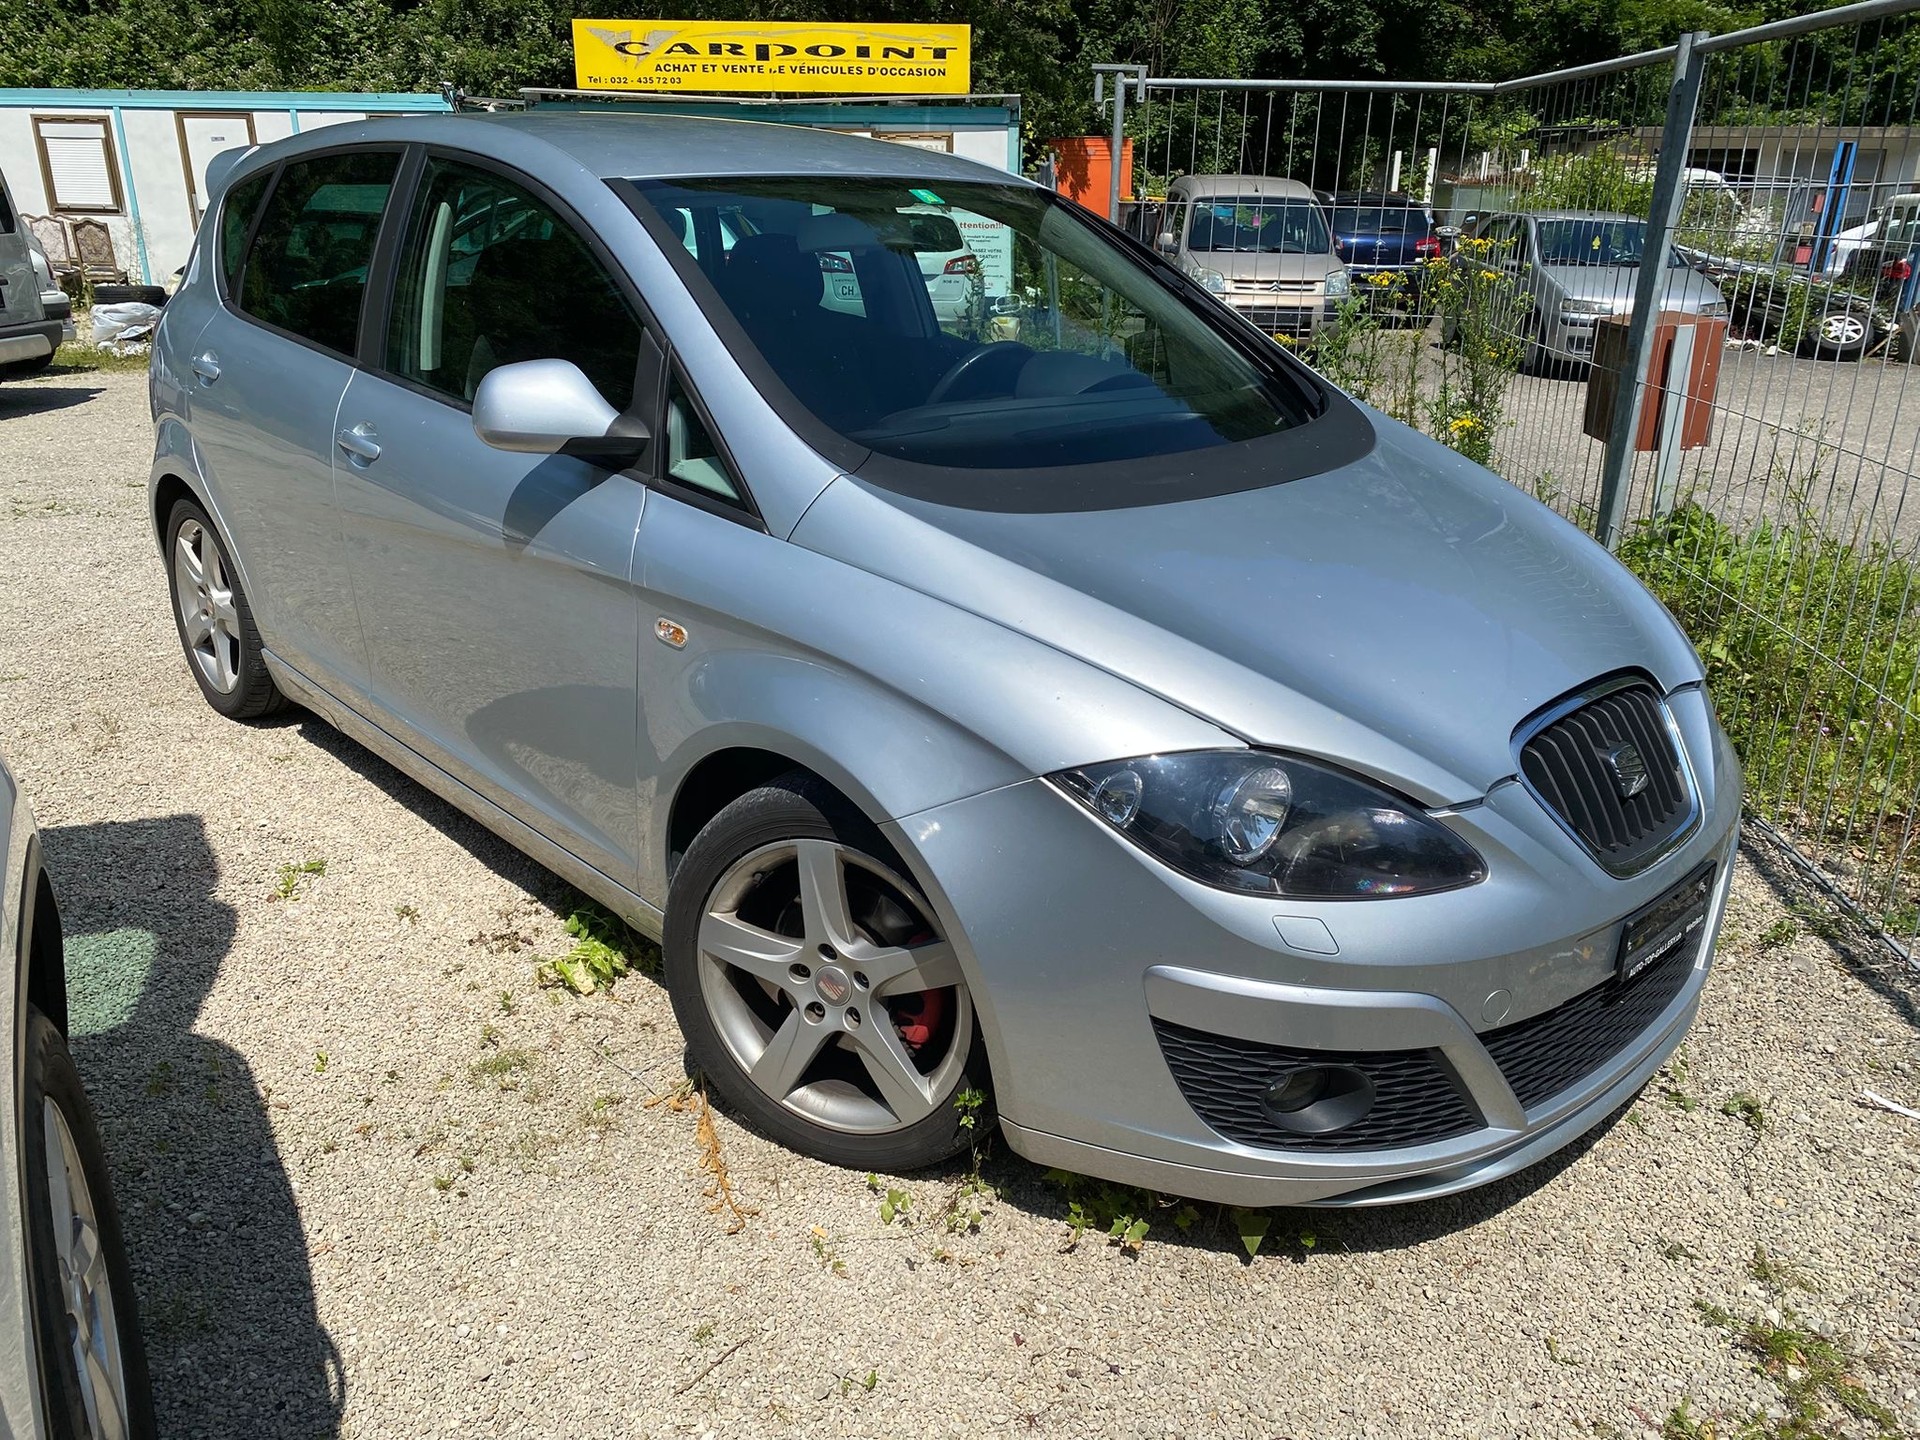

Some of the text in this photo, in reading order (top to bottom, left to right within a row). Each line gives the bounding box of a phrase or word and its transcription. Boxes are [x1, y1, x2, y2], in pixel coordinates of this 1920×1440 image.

[614, 41, 958, 62] CARPOINT
[655, 63, 697, 73] ACHAT
[701, 64, 715, 73] ET
[722, 64, 765, 74] VENTE
[789, 62, 863, 75] VÉHICULES
[867, 67, 947, 77] D'OCCASION
[610, 76, 628, 84] 032
[636, 76, 654, 85] 435
[657, 77, 669, 85] 72
[670, 77, 682, 85] 03
[959, 221, 1004, 229] ttention!!!
[841, 285, 854, 296] CH
